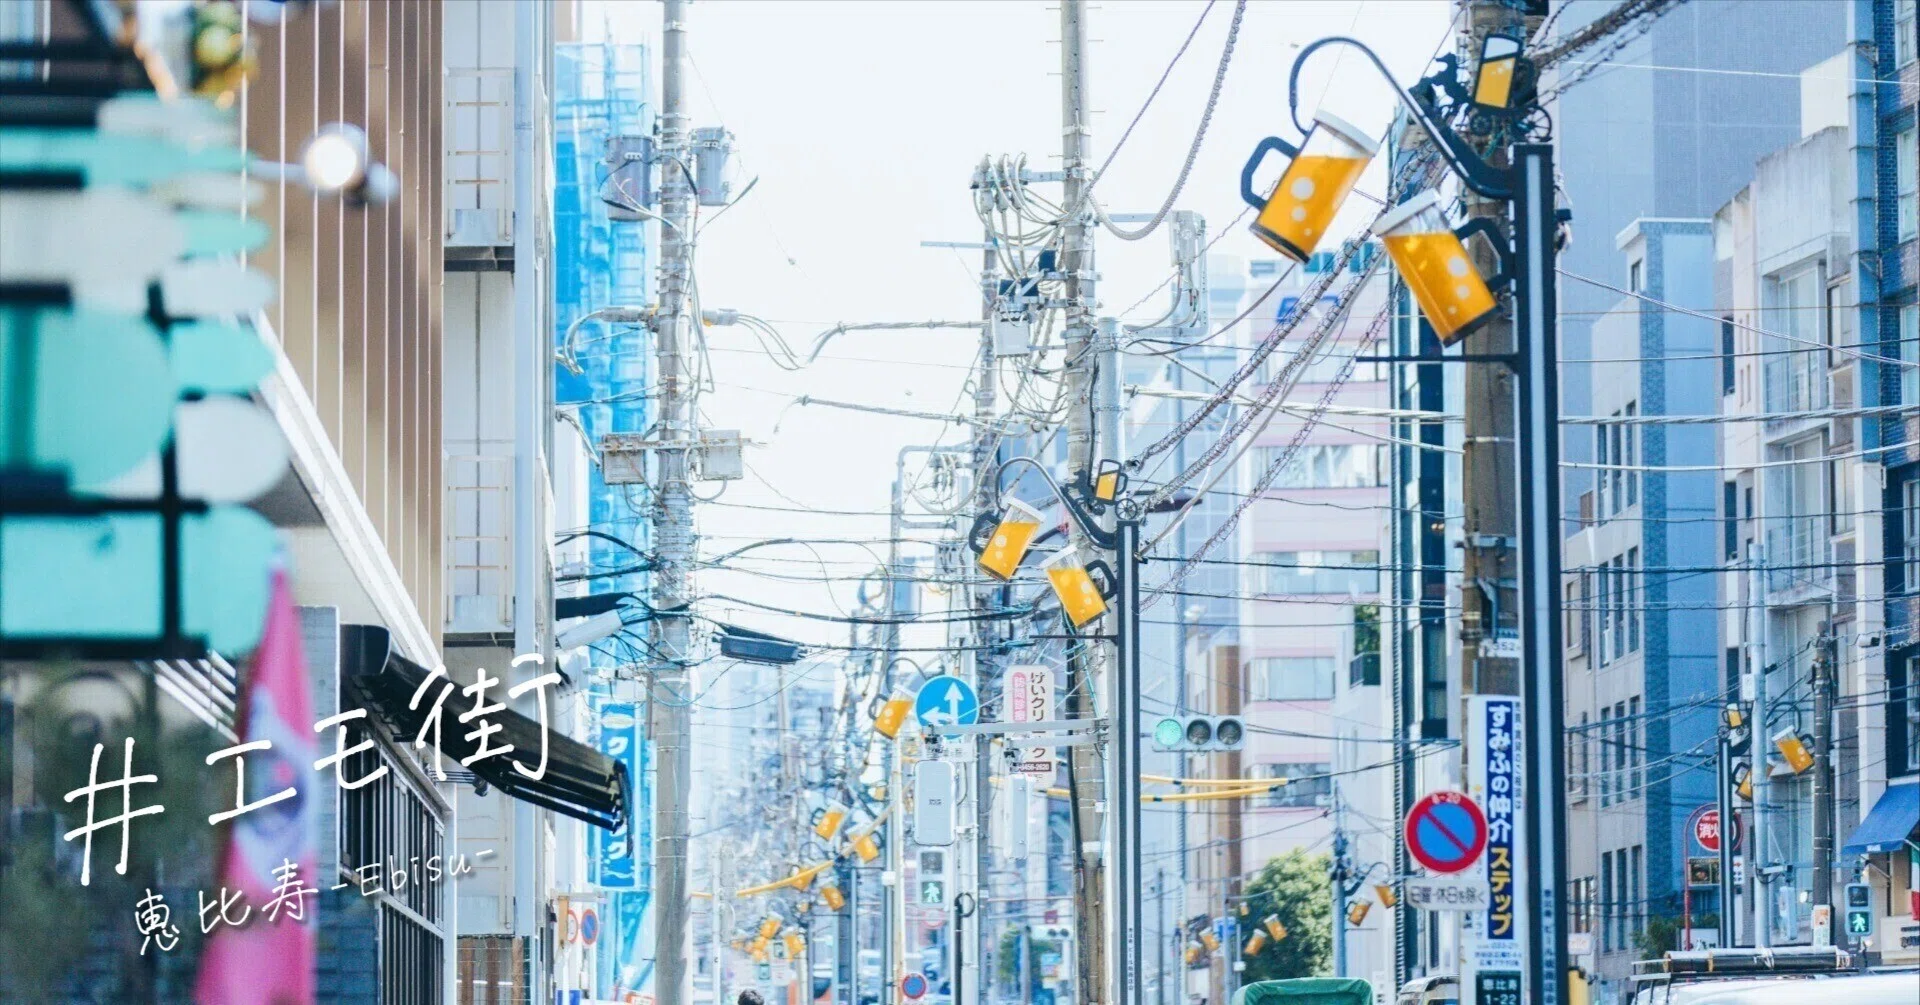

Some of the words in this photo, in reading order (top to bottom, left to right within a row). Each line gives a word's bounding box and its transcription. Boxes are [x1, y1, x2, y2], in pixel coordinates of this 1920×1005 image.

[1031, 671, 1046, 758] けいクリク
[1488, 704, 1512, 936] すみふの仲介ステップ
[1483, 978, 1517, 991] 恵比寿
